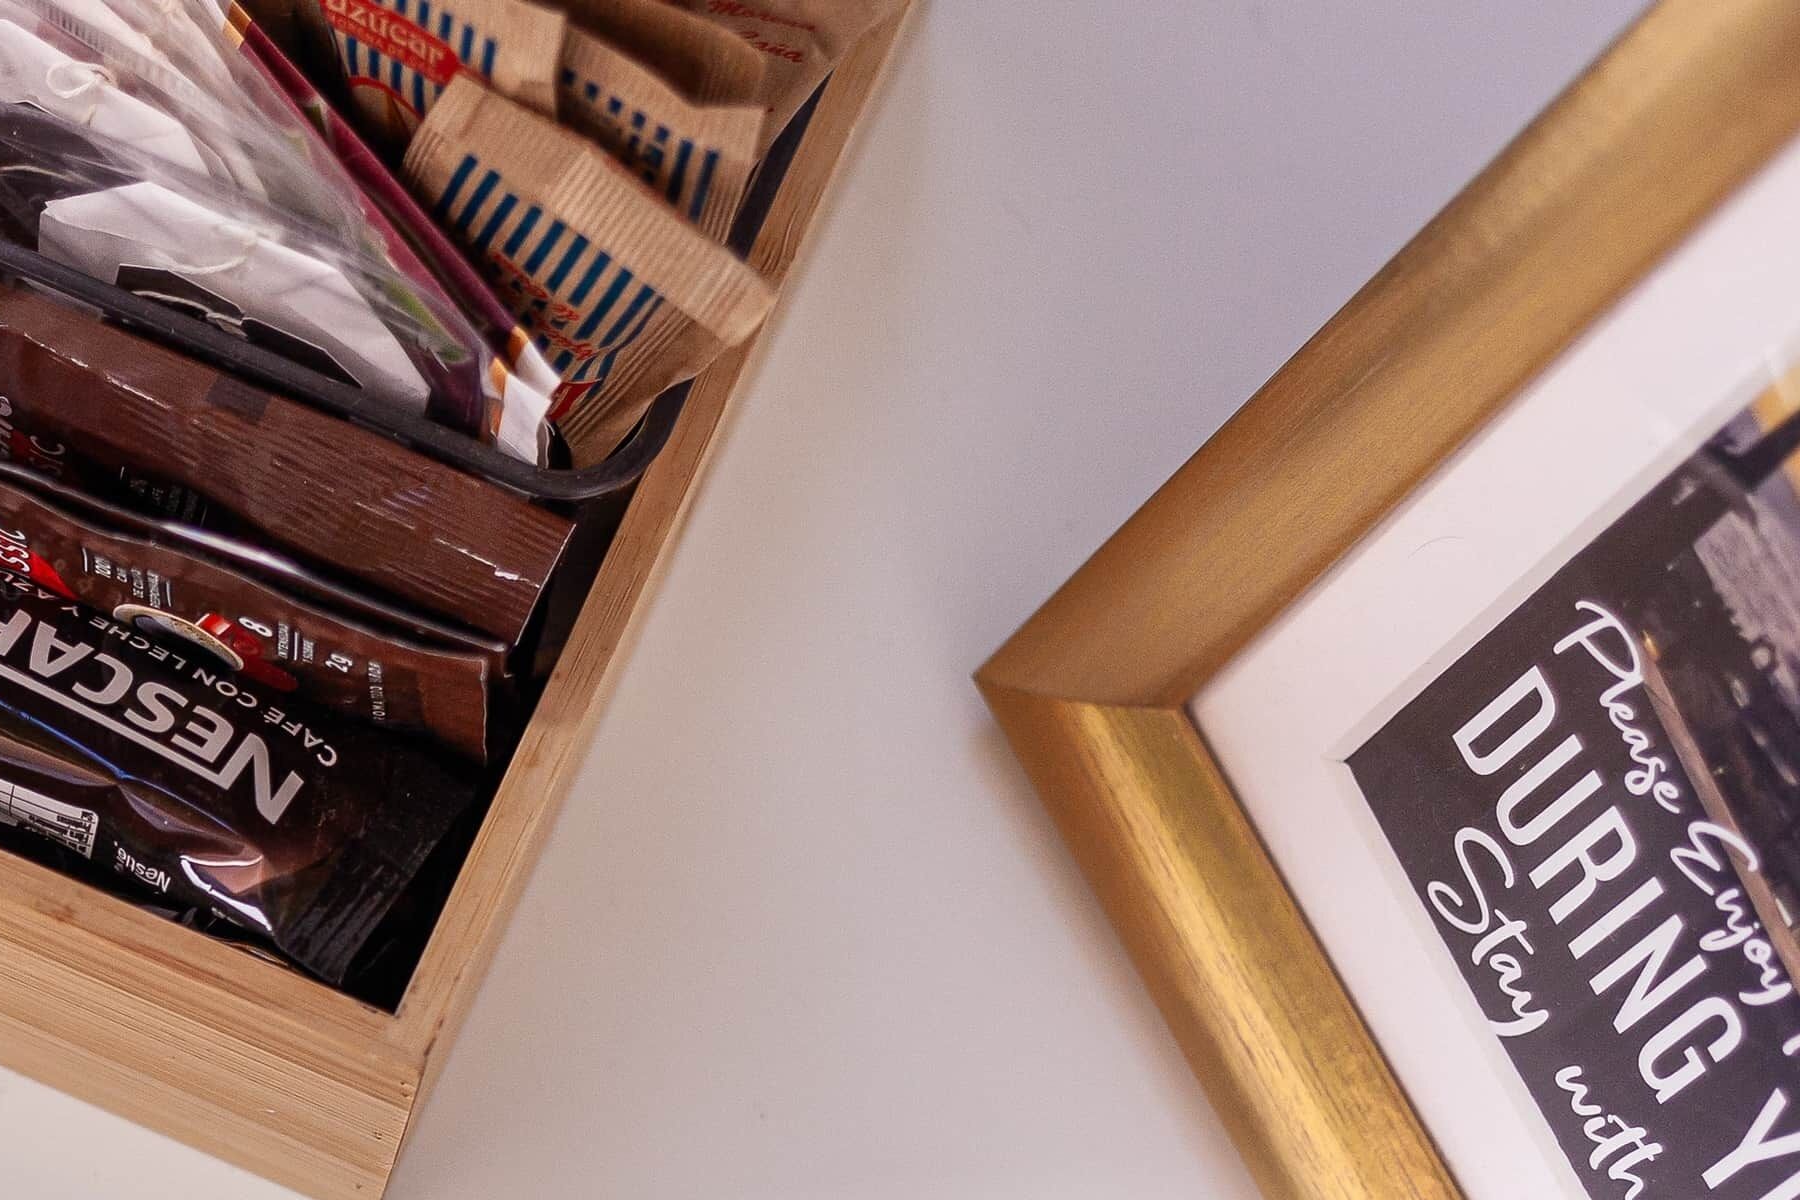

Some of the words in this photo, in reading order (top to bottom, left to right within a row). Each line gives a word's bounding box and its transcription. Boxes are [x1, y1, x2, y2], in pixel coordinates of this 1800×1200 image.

[89, 616, 187, 670] LECHE
[238, 616, 273, 638] 8
[192, 666, 257, 708] CON
[325, 652, 353, 673] 2g
[264, 706, 338, 767] CAFÉ
[1553, 600, 1680, 814] Please
[1670, 822, 1792, 1005] Enjoy
[1452, 665, 1742, 1104] DURING
[1428, 827, 1549, 1036] Stay
